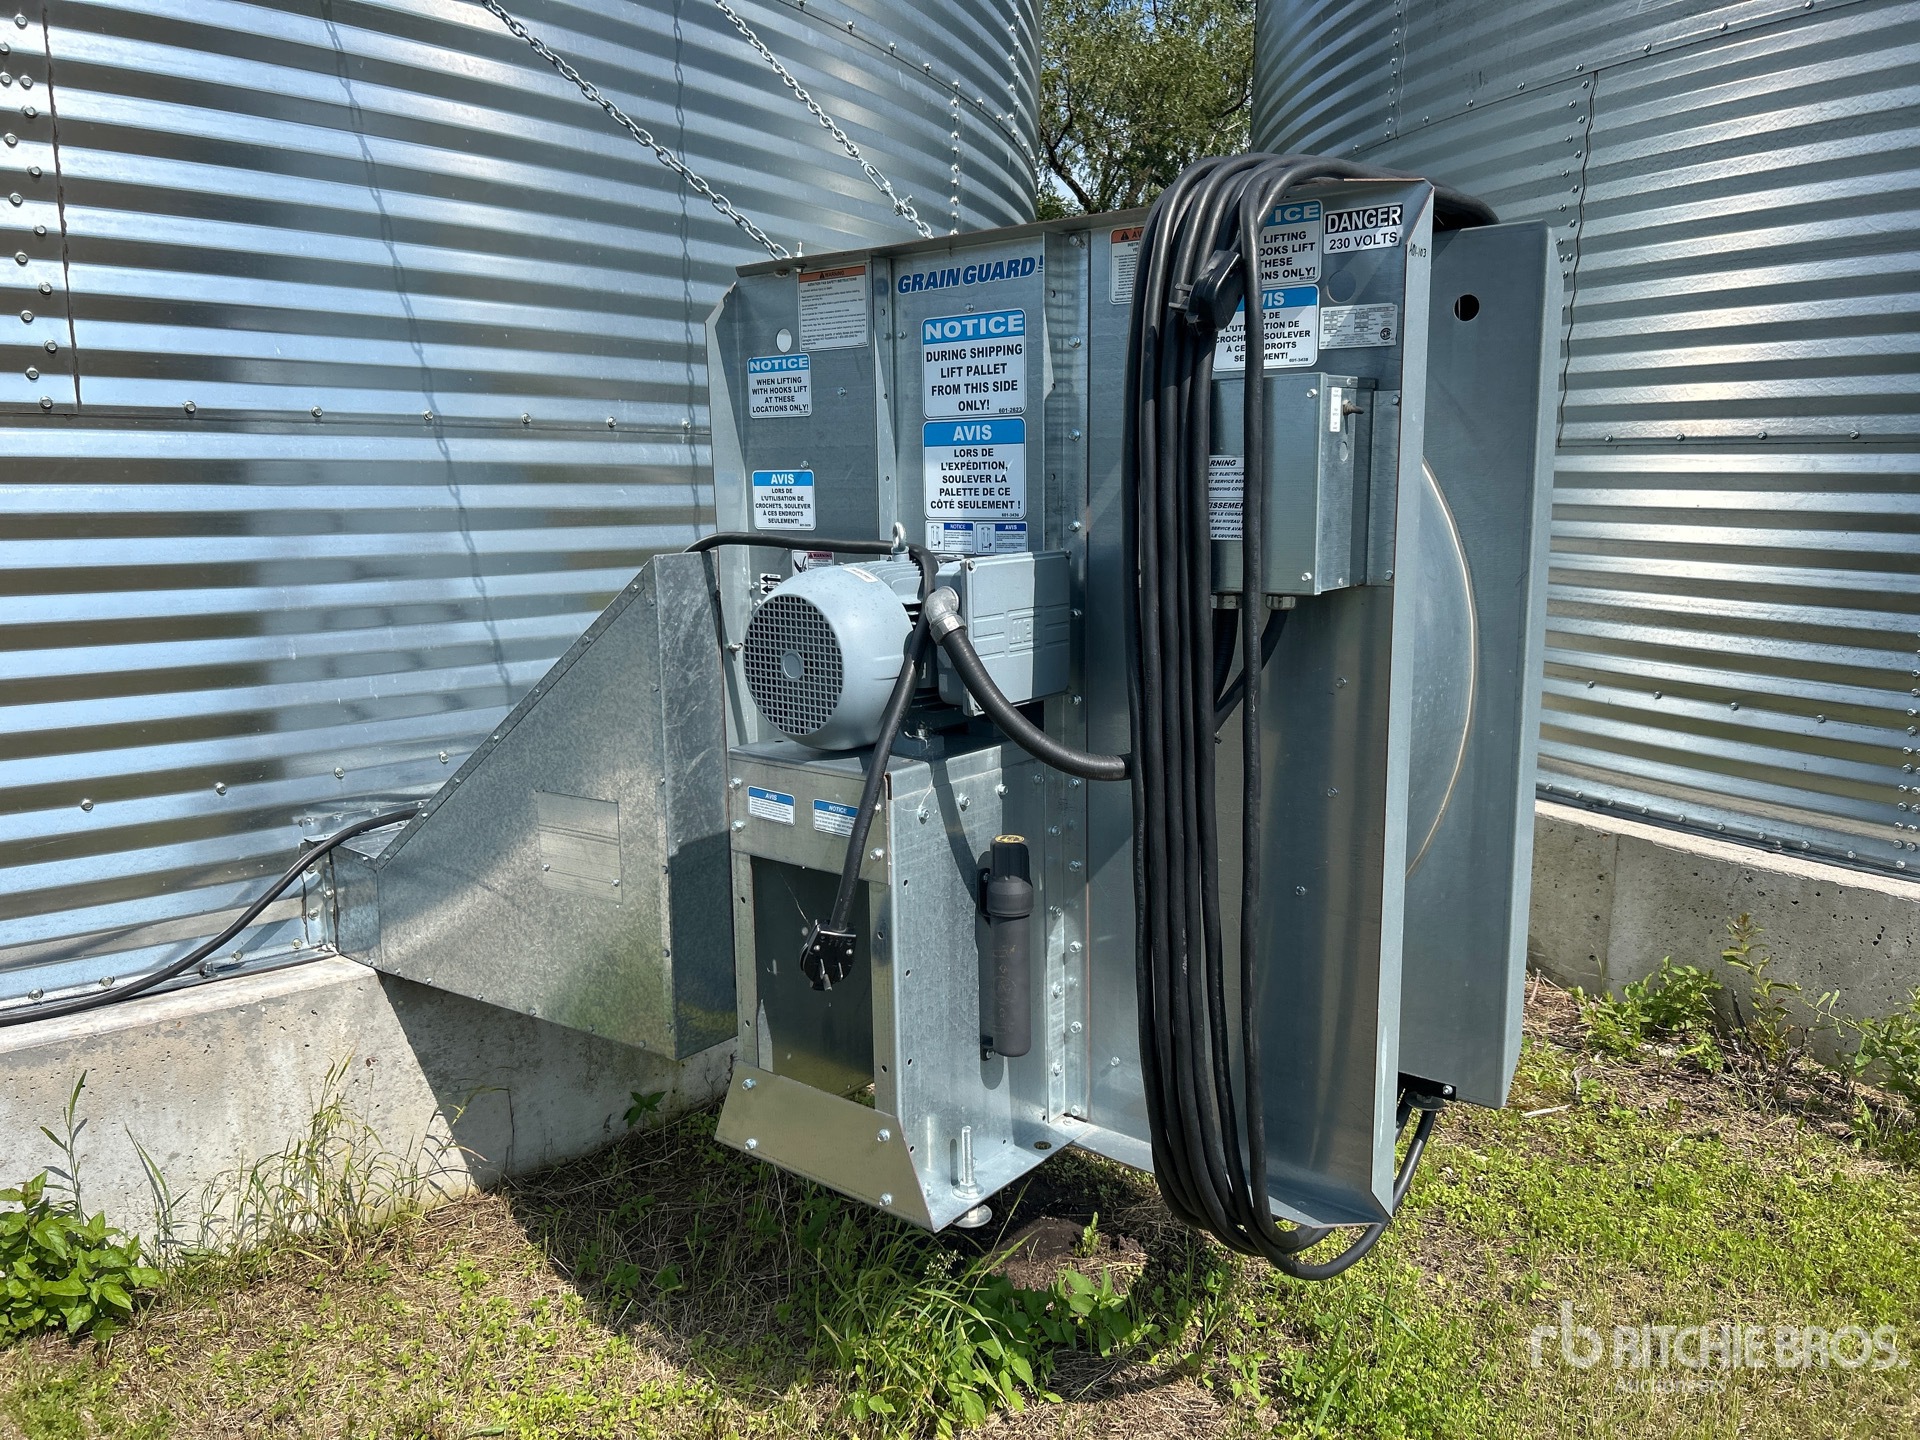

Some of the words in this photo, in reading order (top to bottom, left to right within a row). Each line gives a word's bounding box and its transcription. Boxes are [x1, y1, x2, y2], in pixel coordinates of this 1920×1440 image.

[1275, 204, 1319, 223] ICE
[1327, 206, 1401, 233] DANGER
[1264, 231, 1307, 244] LIFTING
[1329, 237, 1350, 250] 230
[1354, 232, 1397, 247] VOLTS
[1260, 245, 1288, 256] OOKS
[1292, 242, 1316, 253] LIFT
[1282, 267, 1316, 279] ONLY!
[925, 314, 1024, 340] NOTICE
[1264, 330, 1311, 340] SOULEVER
[1265, 341, 1297, 350] DROITS
[926, 348, 967, 363] DURING
[970, 343, 1023, 359] SHIPPING
[750, 357, 808, 371] NOTICE
[940, 366, 963, 379] LIFT
[966, 363, 1007, 377] PALLET
[777, 377, 802, 385] LIFTING
[931, 384, 961, 396] FROM
[964, 382, 989, 394] THIS
[992, 380, 1018, 392] SIDE
[752, 405, 787, 413] LOCATIONS
[958, 399, 990, 412] ONLY!
[953, 425, 992, 441] AVIS
[954, 449, 978, 458] LORS
[982, 448, 994, 457] DE
[941, 460, 1008, 471] L'EXPÉDITION,
[771, 474, 795, 485] AVIS
[942, 475, 992, 484] SOULEVER
[995, 474, 1007, 483] LA
[939, 488, 980, 496] PALETTE
[982, 488, 995, 496] DE
[998, 487, 1011, 496] CE
[930, 499, 955, 509] CÔTÉ
[957, 500, 1015, 509] SEULEMENT
[765, 793, 778, 801] AVIS
[829, 804, 848, 815] NOTICE
